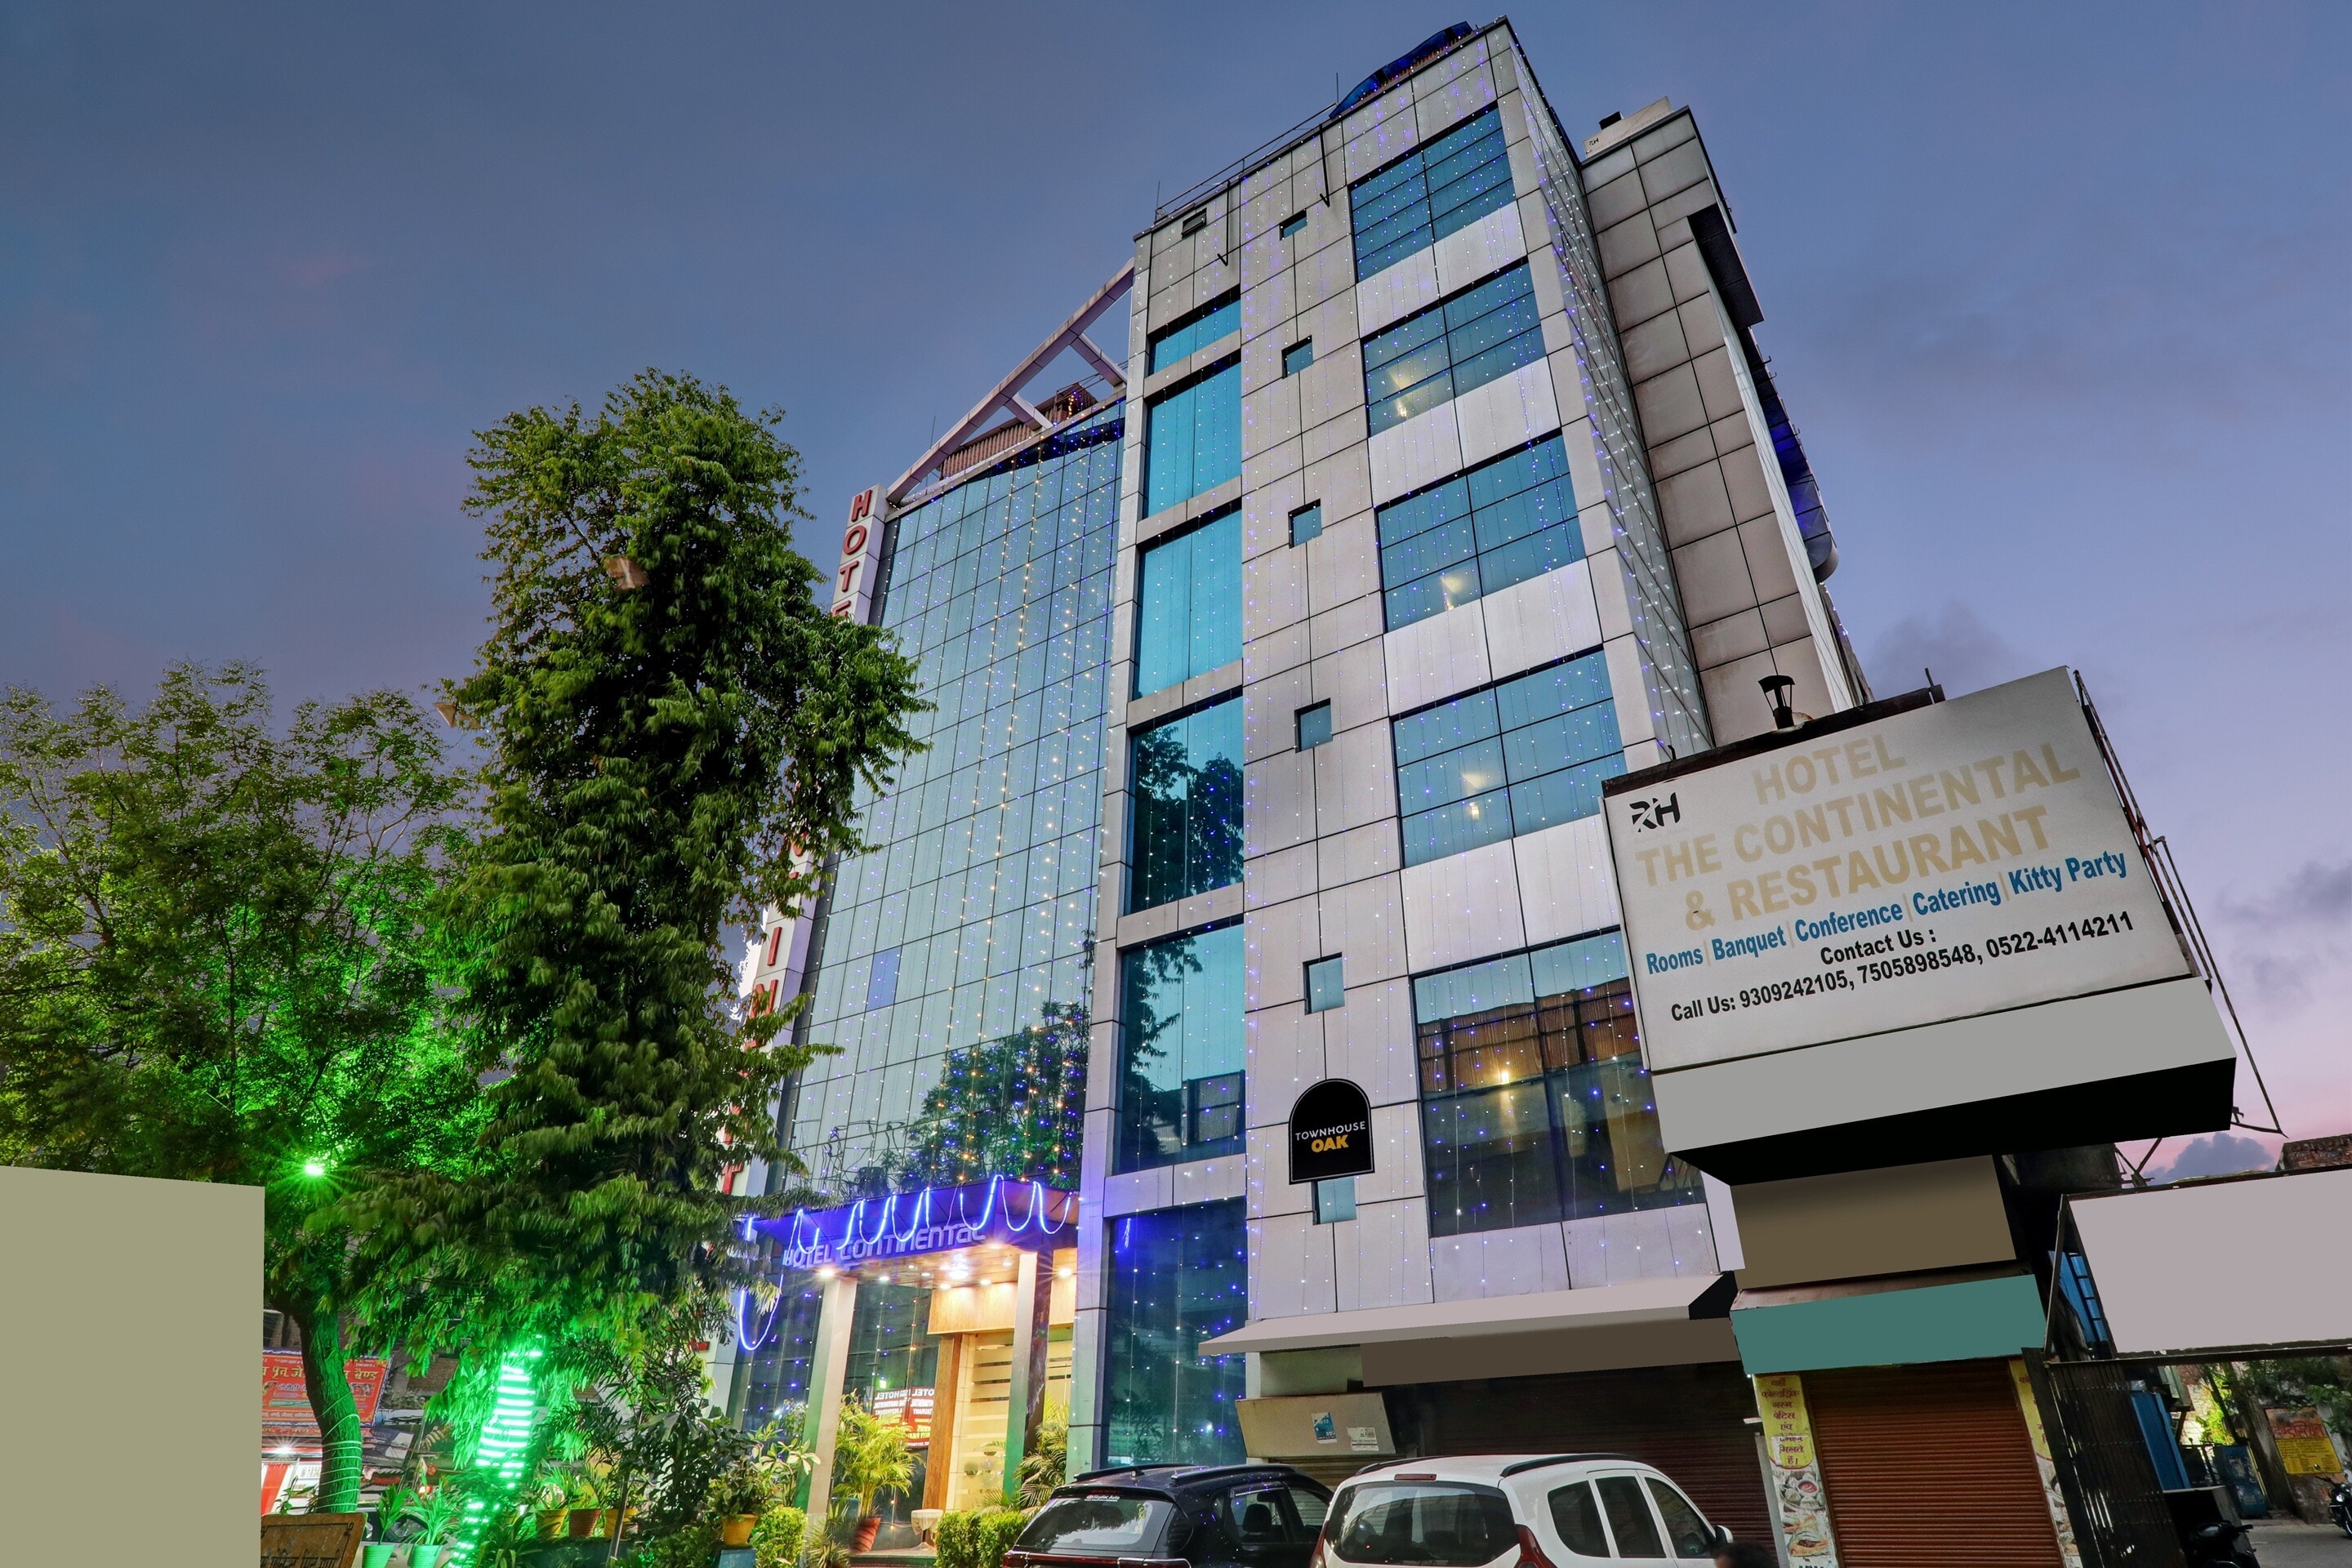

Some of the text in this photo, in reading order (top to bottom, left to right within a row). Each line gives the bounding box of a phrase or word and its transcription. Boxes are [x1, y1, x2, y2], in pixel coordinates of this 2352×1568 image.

[1752, 737, 1907, 805] HOTEL
[1636, 742, 2081, 887] THE CONTINENTAL
[1684, 805, 2049, 930] & RESTAURANT
[1646, 850, 2127, 974] Rooms Banquet Conference Catering Kitty Party
[1671, 911, 2134, 1021] Call Us: 9309242105, 7505898548, 0522-4114211
[1820, 934, 1895, 965] Contact
[1897, 929, 1925, 948] Us
[1295, 1120, 1366, 1141] TOWNHOUSE
[1311, 1134, 1349, 1153] OAK
[782, 1244, 832, 1267] HOTEL
